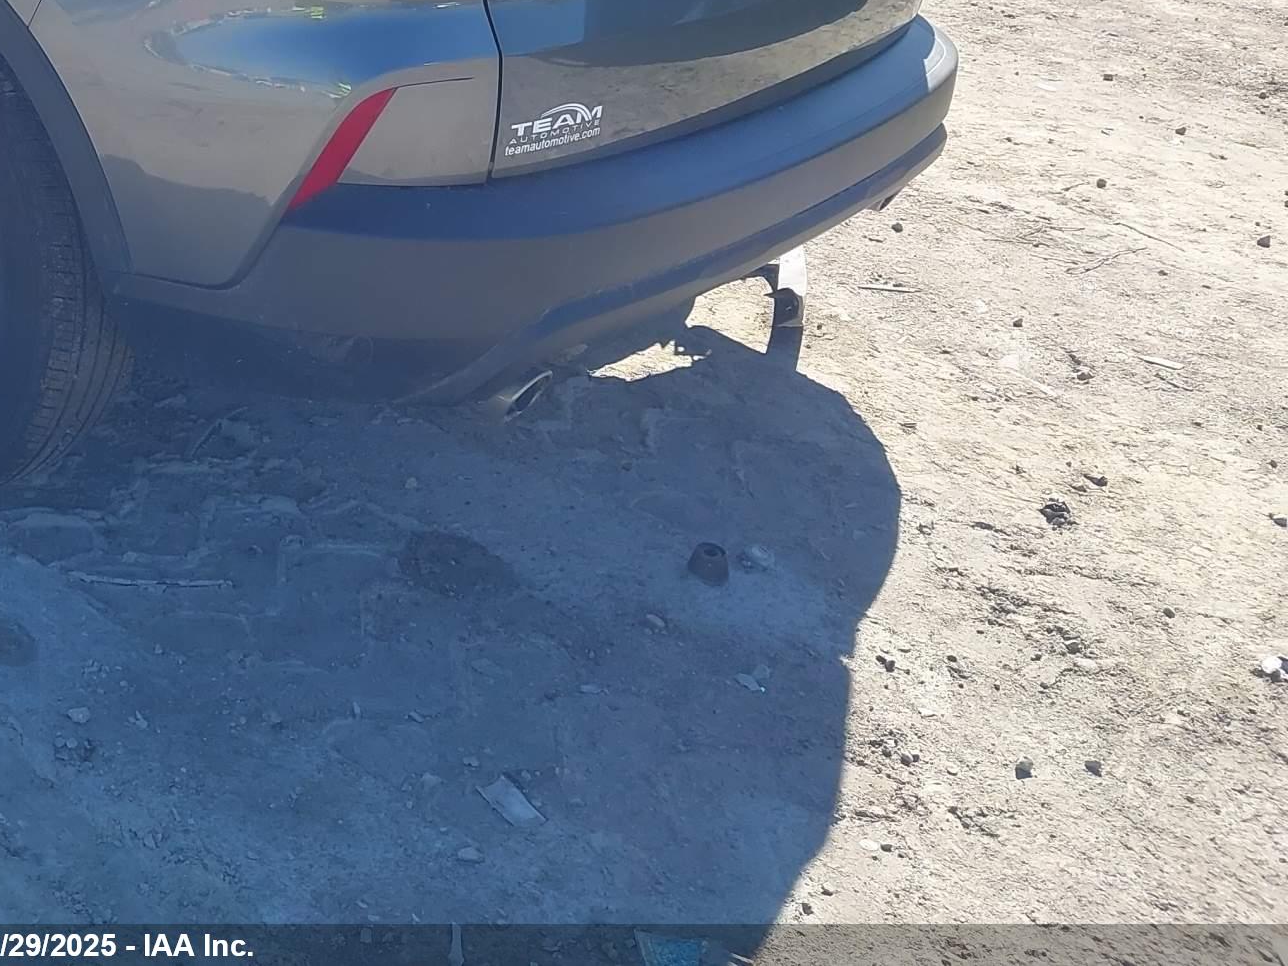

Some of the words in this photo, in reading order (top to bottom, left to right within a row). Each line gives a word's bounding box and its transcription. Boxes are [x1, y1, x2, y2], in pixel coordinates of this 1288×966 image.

[509, 119, 601, 145] AUTOMOTIVE
[511, 105, 603, 137] TEAM
[505, 127, 601, 156] teamautomotive.com
